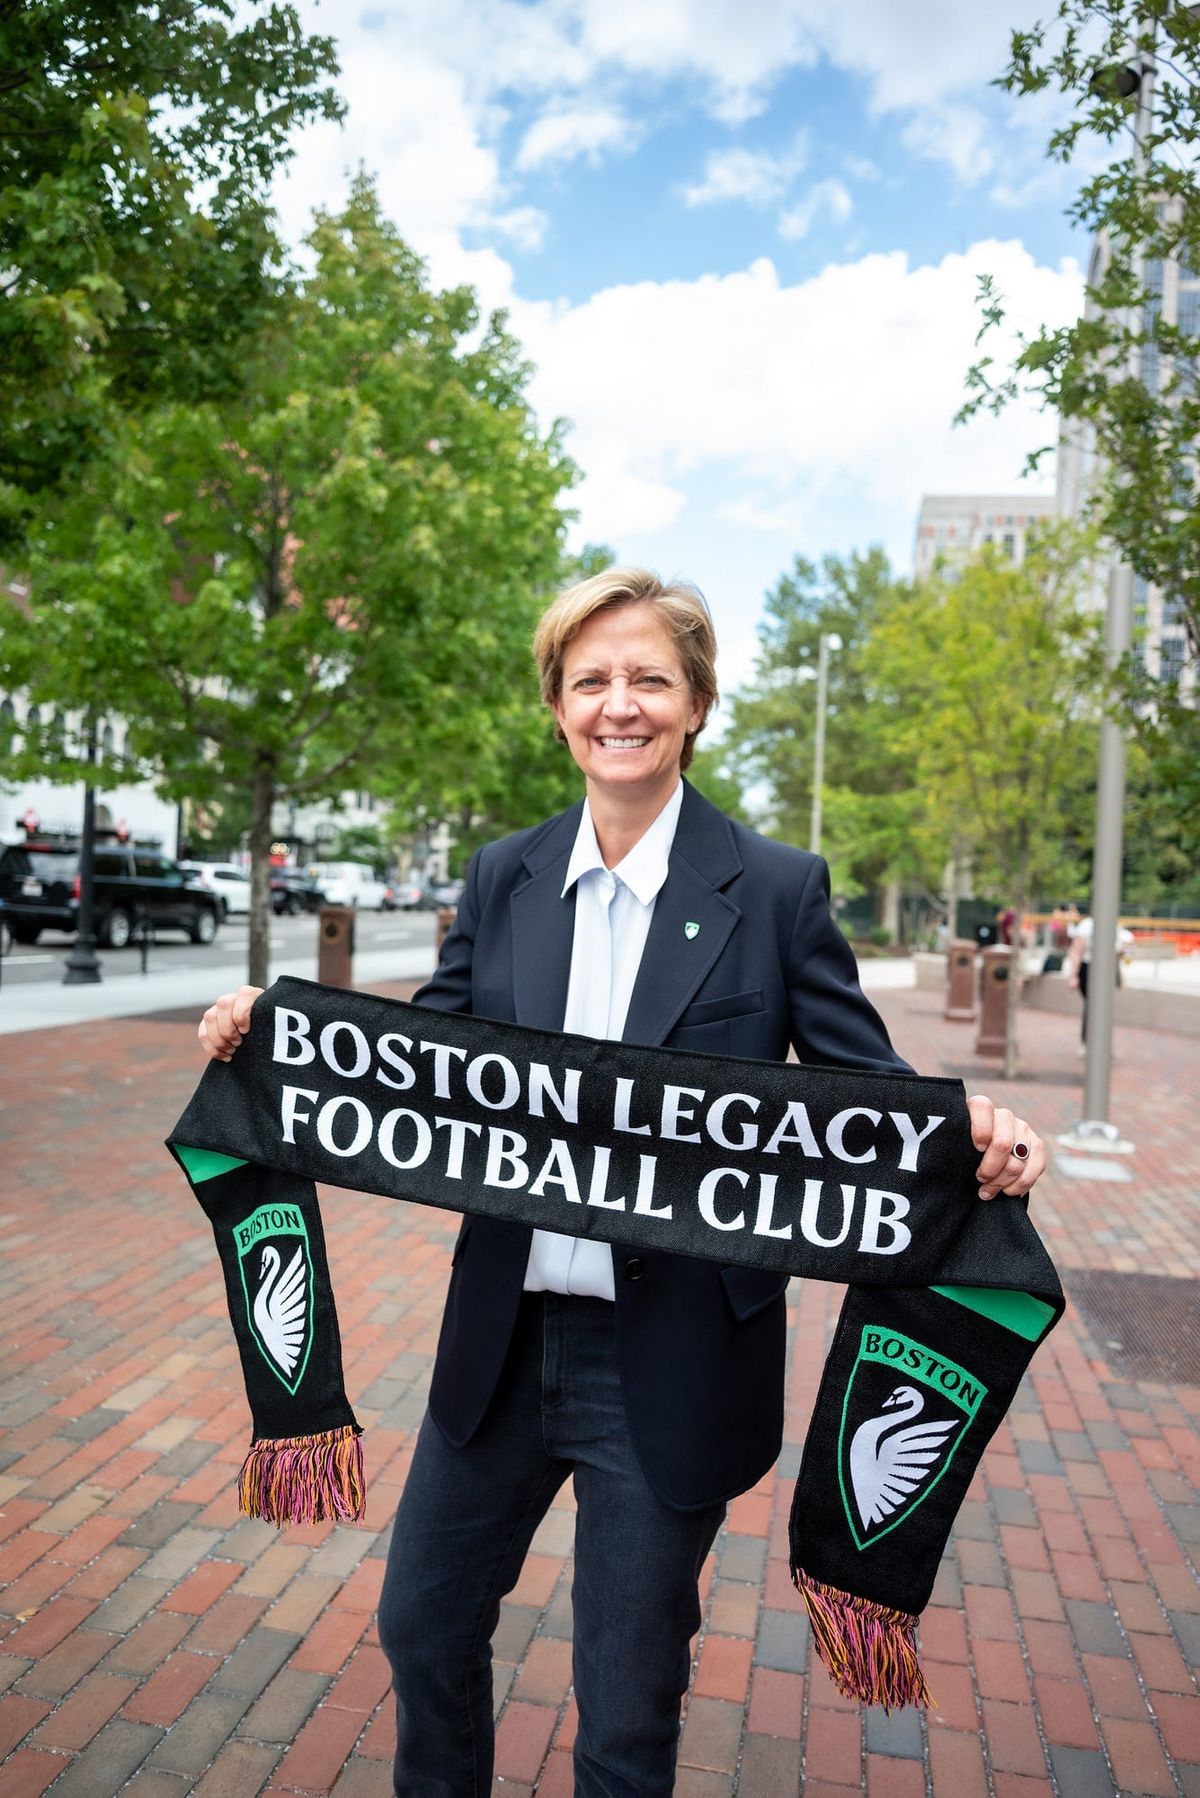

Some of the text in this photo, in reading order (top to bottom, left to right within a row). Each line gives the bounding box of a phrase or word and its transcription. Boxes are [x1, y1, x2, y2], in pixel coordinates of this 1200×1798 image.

[272, 1006, 946, 1172] BOSTON LEGACY
[239, 1209, 300, 1248] BOSTON
[281, 1086, 911, 1256] FOOTBALL CLUB
[865, 1333, 980, 1408] BOSTON
